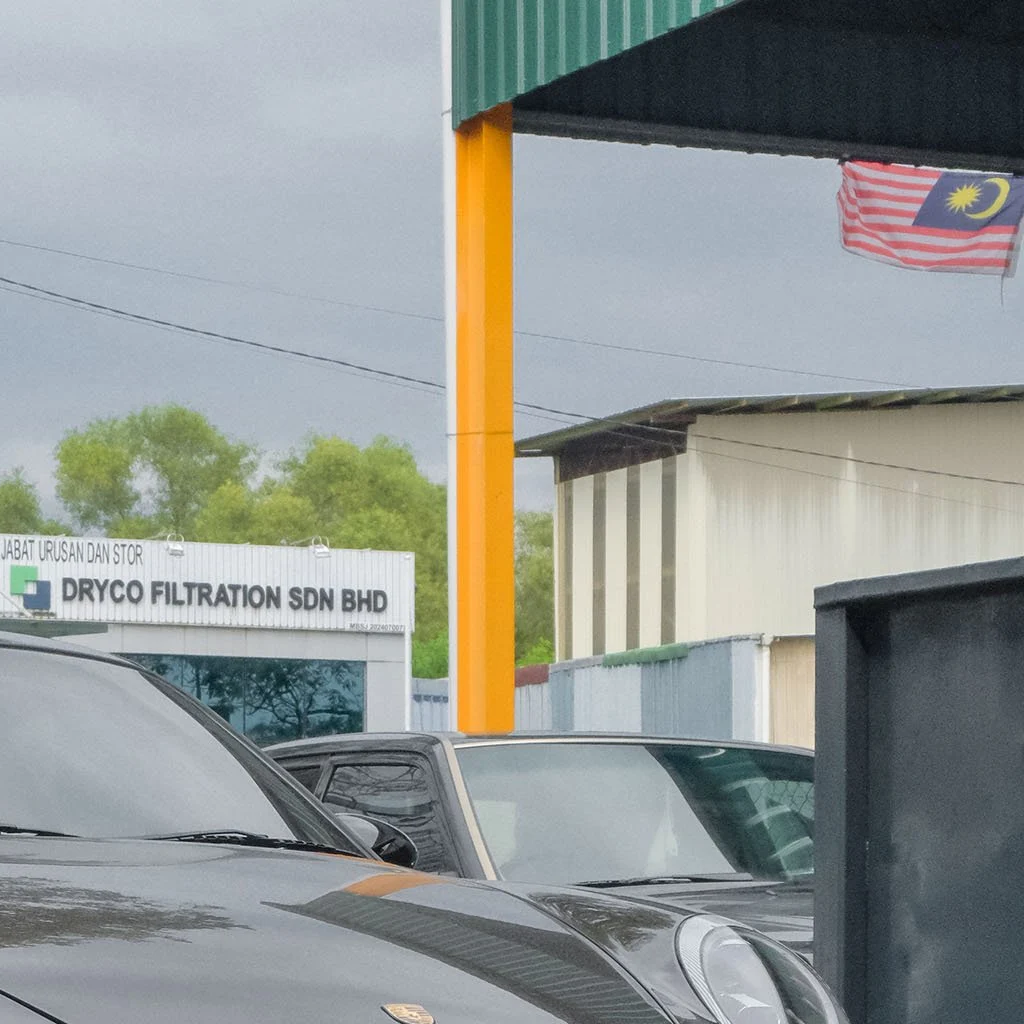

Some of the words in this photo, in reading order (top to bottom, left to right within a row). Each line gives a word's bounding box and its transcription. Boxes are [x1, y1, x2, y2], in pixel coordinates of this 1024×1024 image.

[39, 540, 84, 562] URUSAN
[88, 542, 110, 564] DAN
[113, 543, 143, 565] STOR
[62, 577, 144, 604] DRYCO
[151, 581, 281, 609] FILTRATION
[288, 586, 334, 611] SDN
[341, 588, 388, 613] BHD
